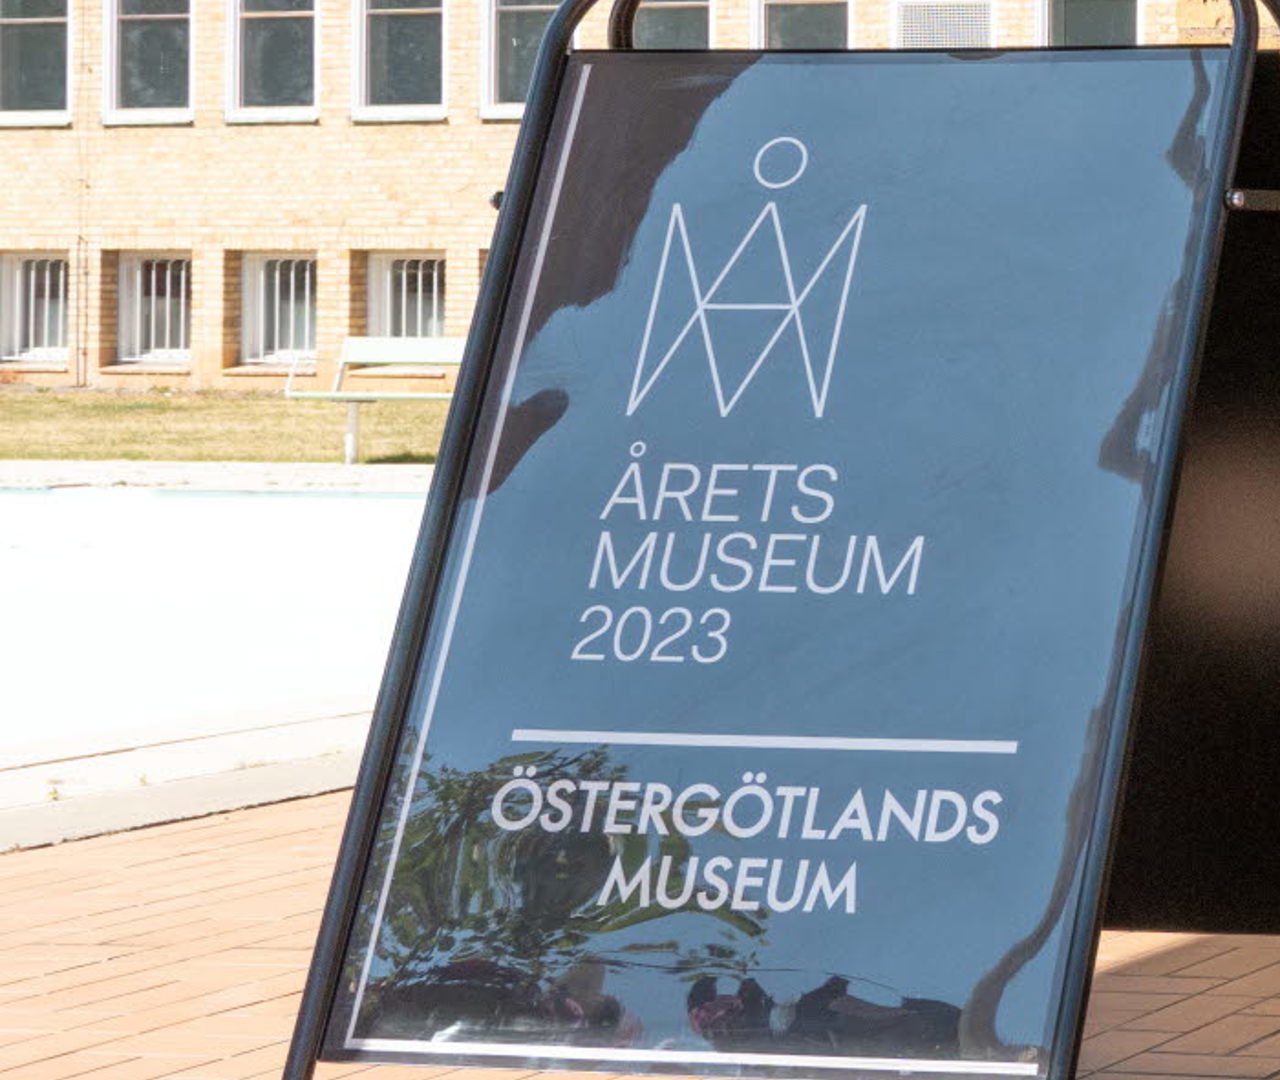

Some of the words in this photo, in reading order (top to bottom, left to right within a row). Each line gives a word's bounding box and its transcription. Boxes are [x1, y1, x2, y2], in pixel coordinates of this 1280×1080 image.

[599, 440, 838, 524] ÅRETS
[588, 531, 925, 596] MUSEUM
[570, 604, 731, 663] 2023
[491, 765, 1003, 845] ÖSTERGÖTLANDS
[597, 855, 857, 914] MUSEUM
